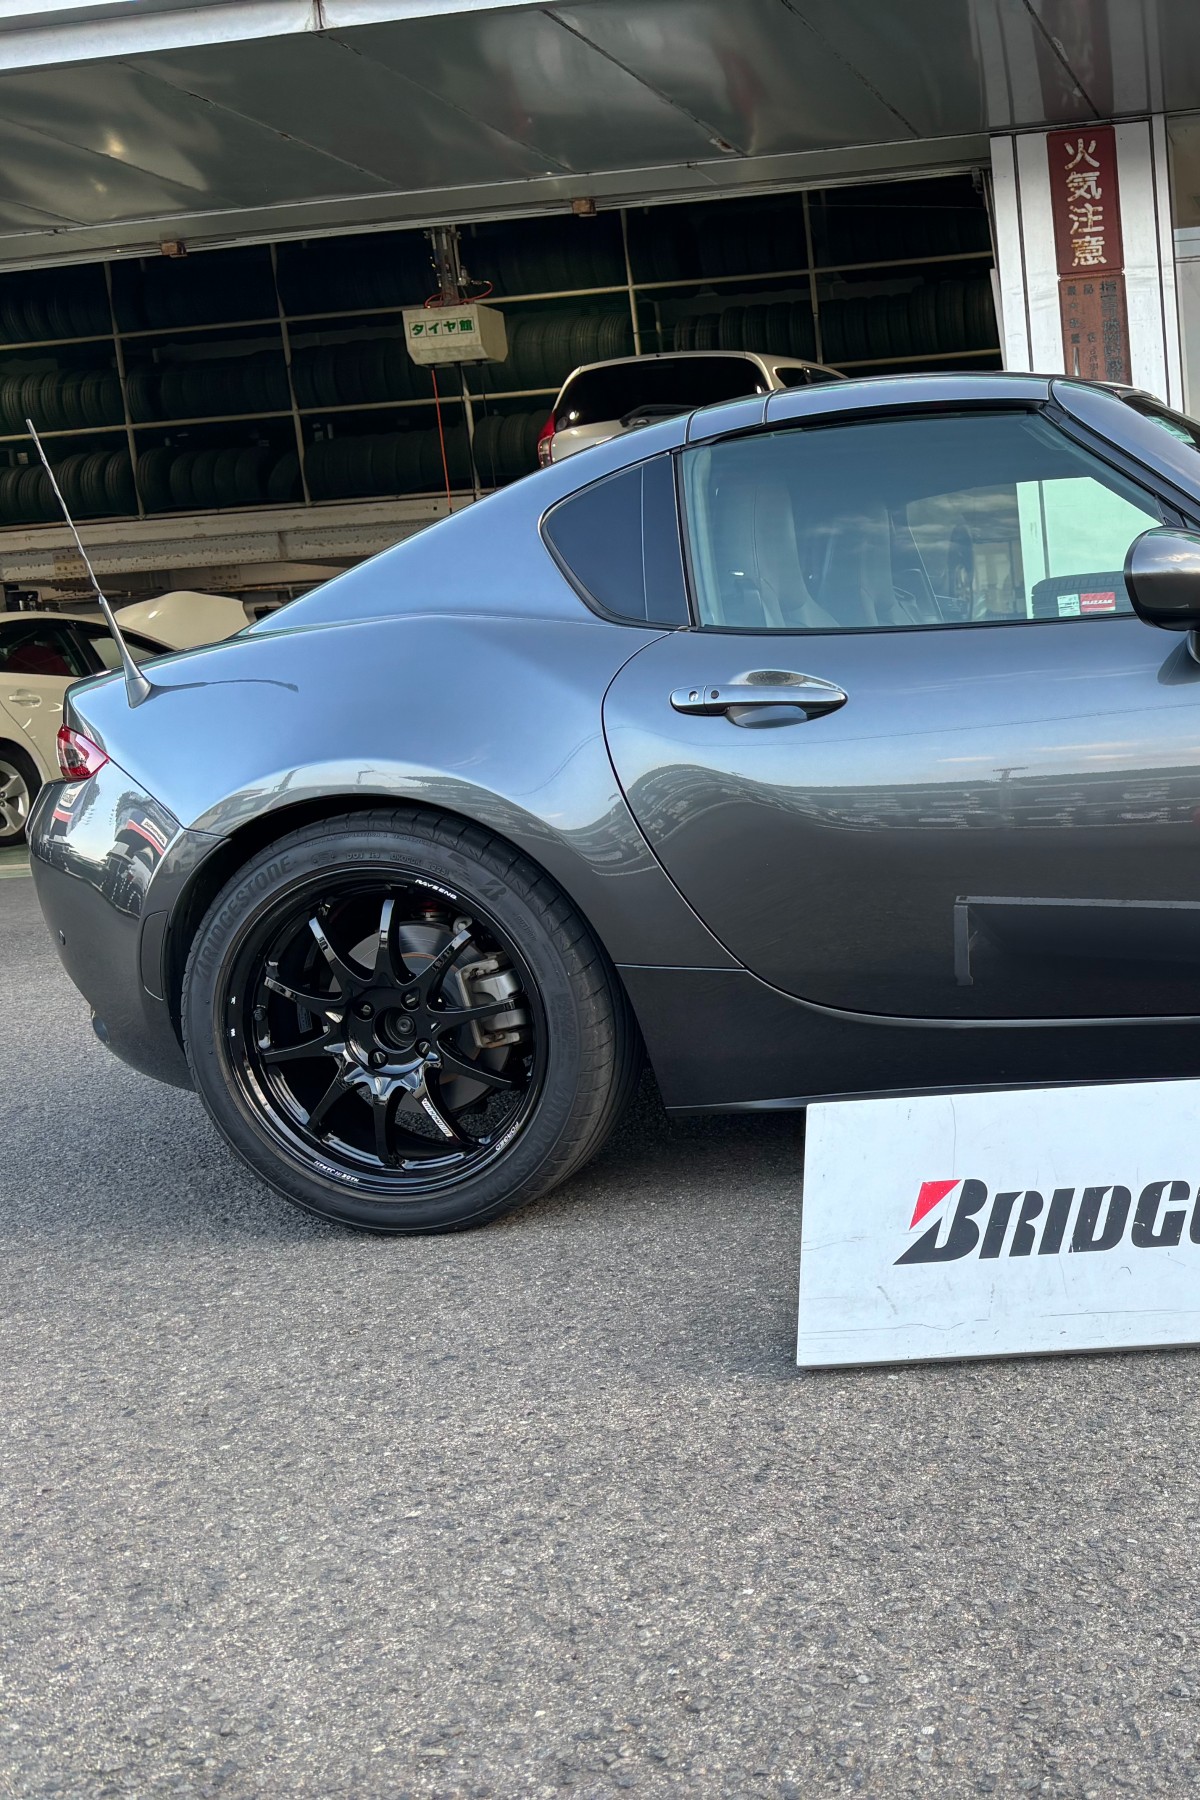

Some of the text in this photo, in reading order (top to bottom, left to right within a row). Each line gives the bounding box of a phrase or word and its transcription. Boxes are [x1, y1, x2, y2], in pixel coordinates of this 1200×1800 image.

[1064, 138, 1107, 266] 火気注意
[411, 319, 473, 336] タイヤ館
[194, 854, 295, 979] BRIDGESTONE
